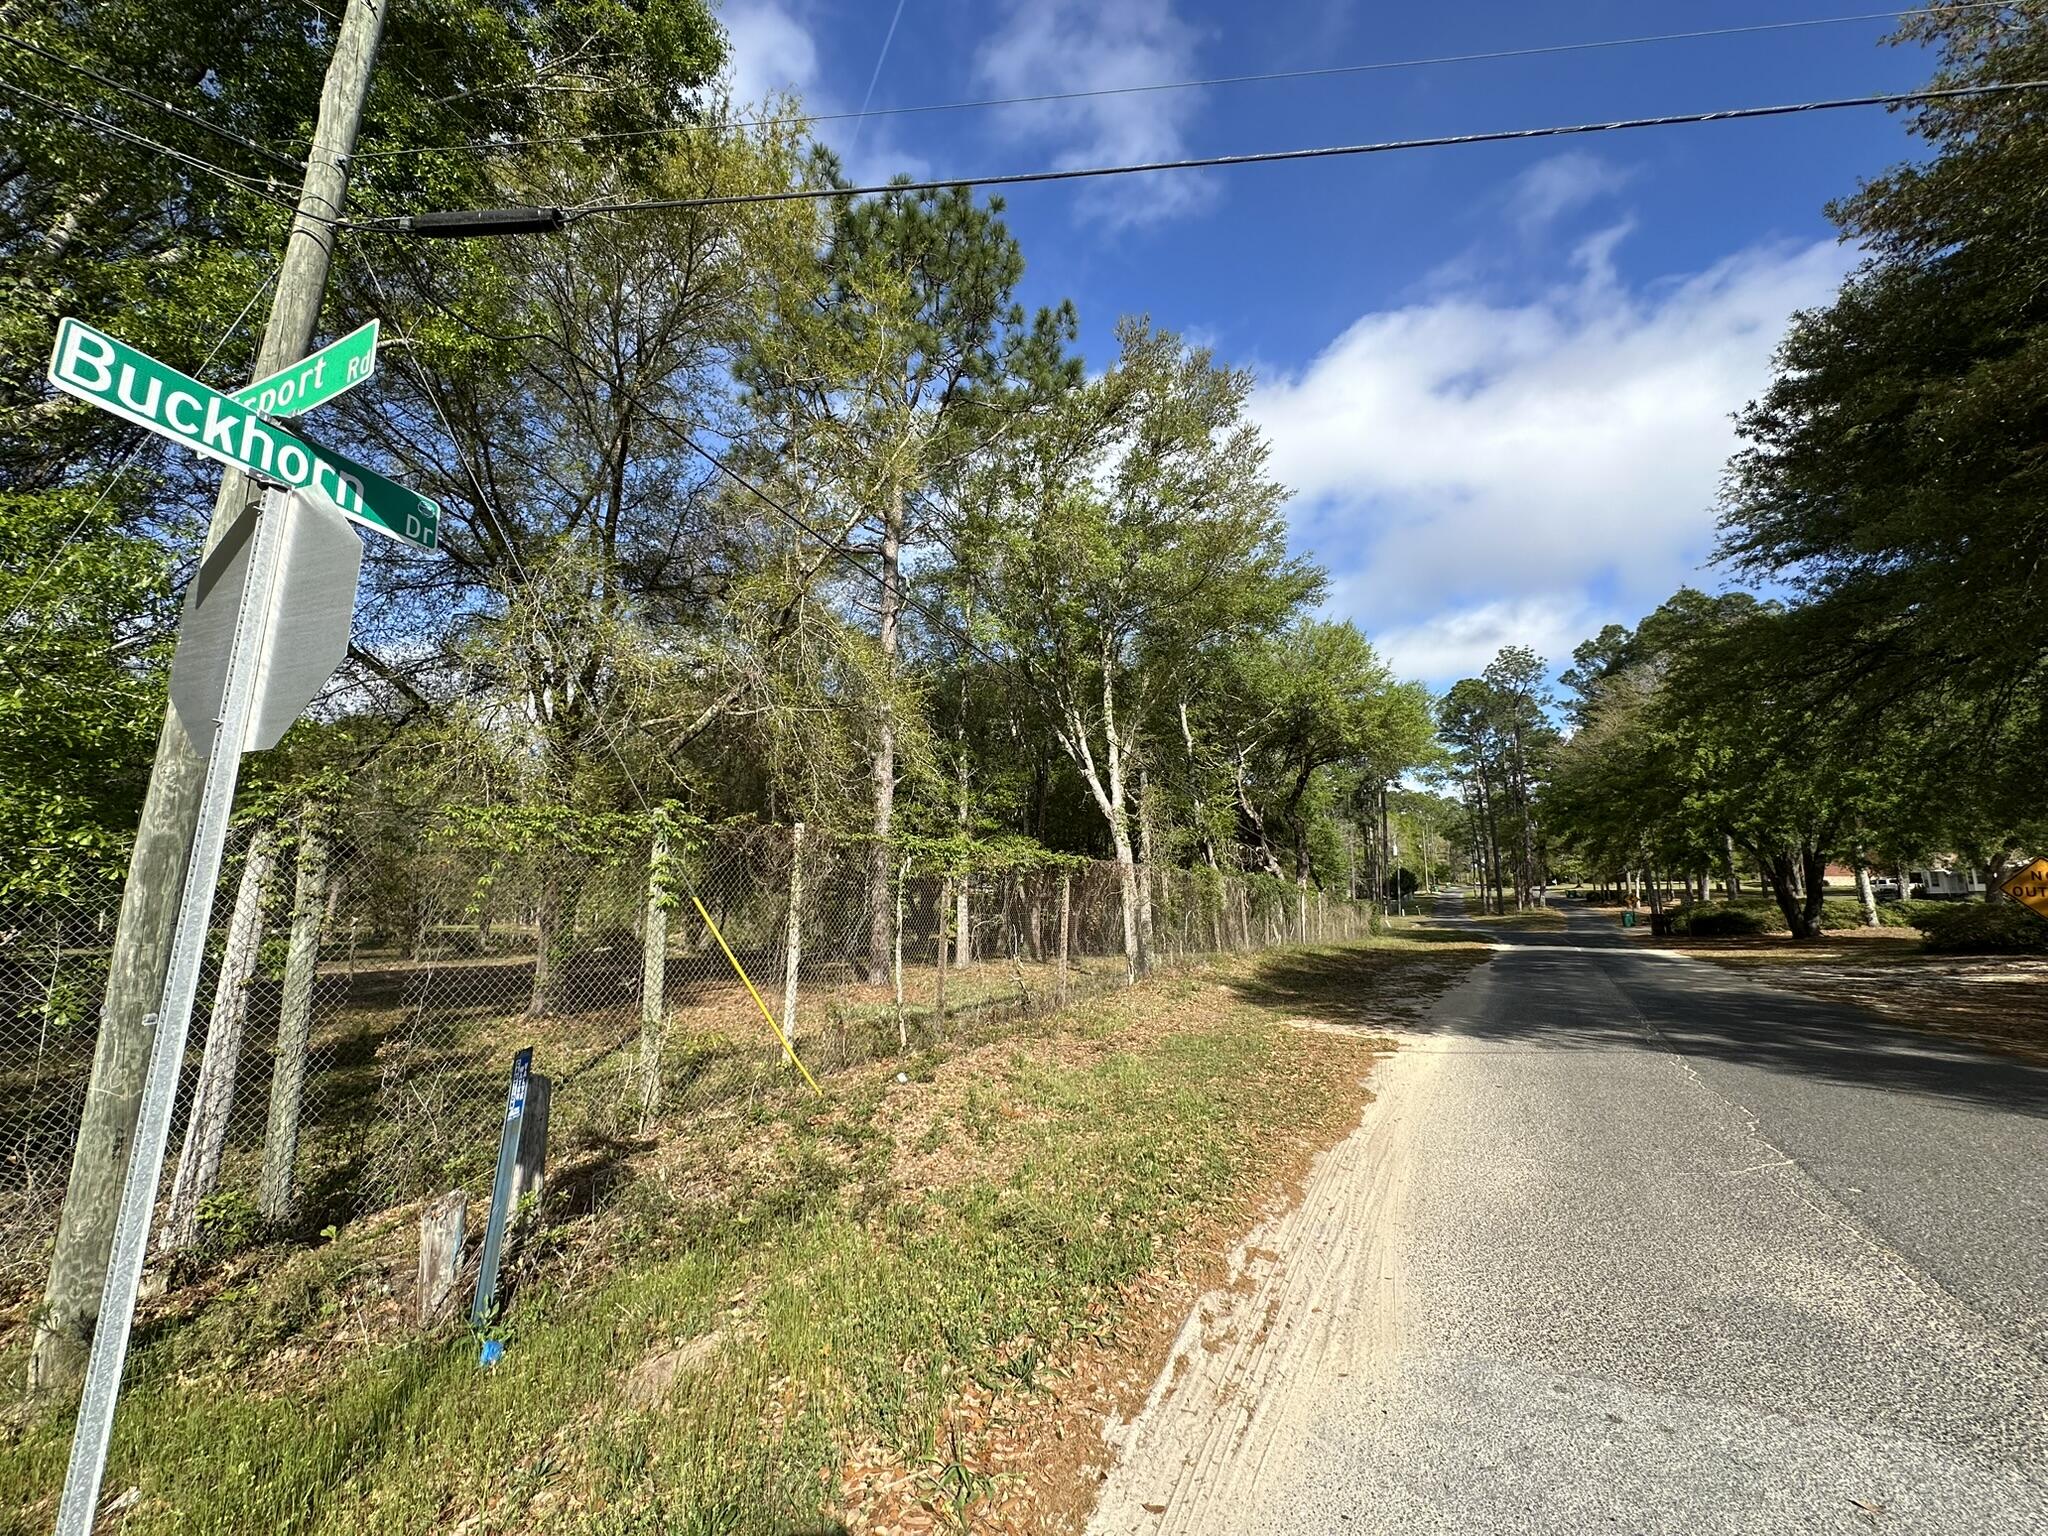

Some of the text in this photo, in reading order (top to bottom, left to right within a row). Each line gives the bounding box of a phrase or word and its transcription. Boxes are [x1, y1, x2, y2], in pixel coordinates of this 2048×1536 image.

[235, 349, 372, 413] port Rd
[59, 324, 433, 544] Buckhorn Dr
[2030, 870, 2048, 881] N
